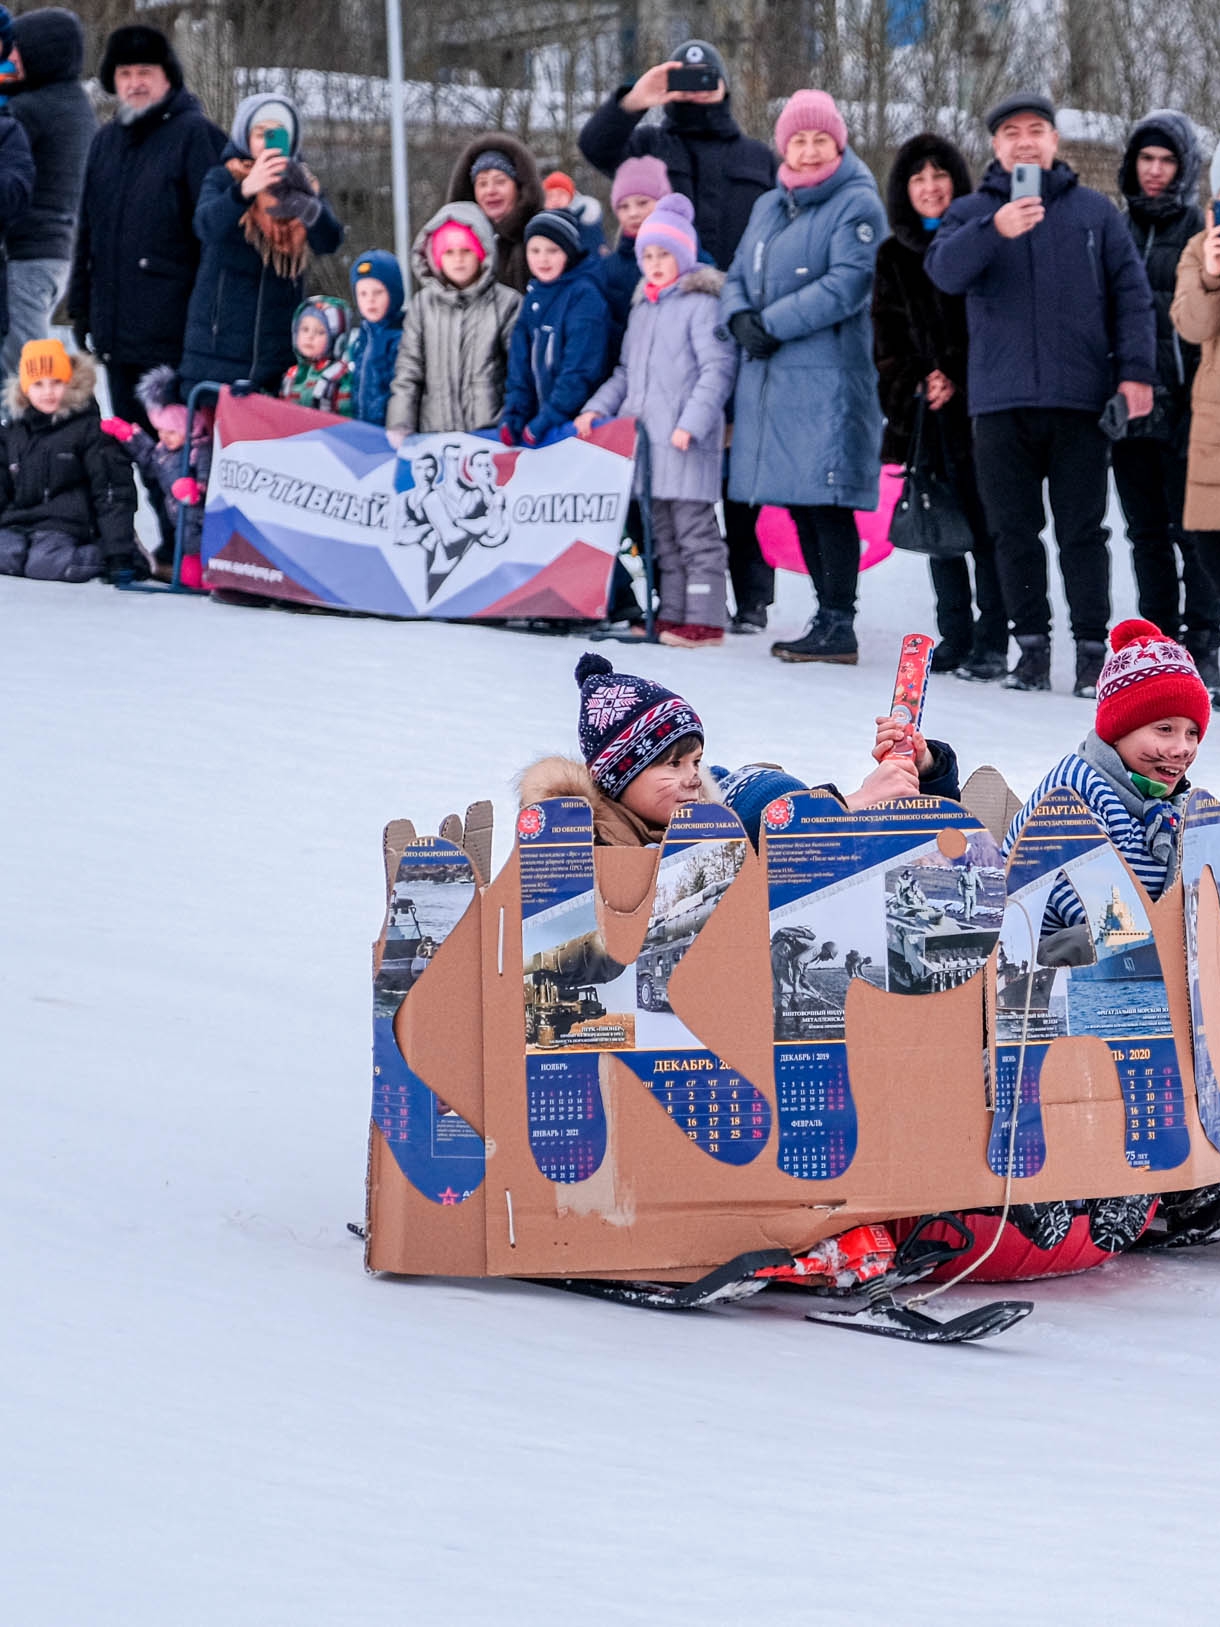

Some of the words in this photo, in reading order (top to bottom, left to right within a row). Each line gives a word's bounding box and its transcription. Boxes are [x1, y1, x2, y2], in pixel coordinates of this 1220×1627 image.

[218, 458, 390, 529] СПОРТИВНЫЙ
[512, 493, 621, 524] ОЛИМП
[1129, 1049, 1150, 1060] 2020
[654, 1059, 714, 1072] ДЕКАБРЬ
[1130, 1081, 1135, 1089] 2
[1148, 1080, 1152, 1088] 3
[1166, 1079, 1171, 1087] 4
[668, 1092, 672, 1101] 1
[689, 1091, 694, 1100] 2
[711, 1091, 716, 1099] 3
[732, 1091, 737, 1099] 4
[1131, 1094, 1135, 1102] 9
[1146, 1092, 1155, 1101] 10
[666, 1105, 673, 1115] 8
[689, 1105, 695, 1113] 9
[709, 1104, 718, 1112] 10
[730, 1104, 739, 1112] 11
[1131, 1107, 1139, 1115] 16
[1147, 1105, 1155, 1114] 17
[688, 1118, 697, 1127] 16
[709, 1117, 719, 1126] 17
[731, 1117, 740, 1125] 18
[1131, 1120, 1139, 1128] 23
[1147, 1119, 1155, 1127] 24
[709, 1131, 719, 1139] 24
[731, 1130, 741, 1139] 25
[1132, 1132, 1139, 1141] 30
[1148, 1131, 1155, 1140] 31
[710, 1144, 718, 1152] 31
